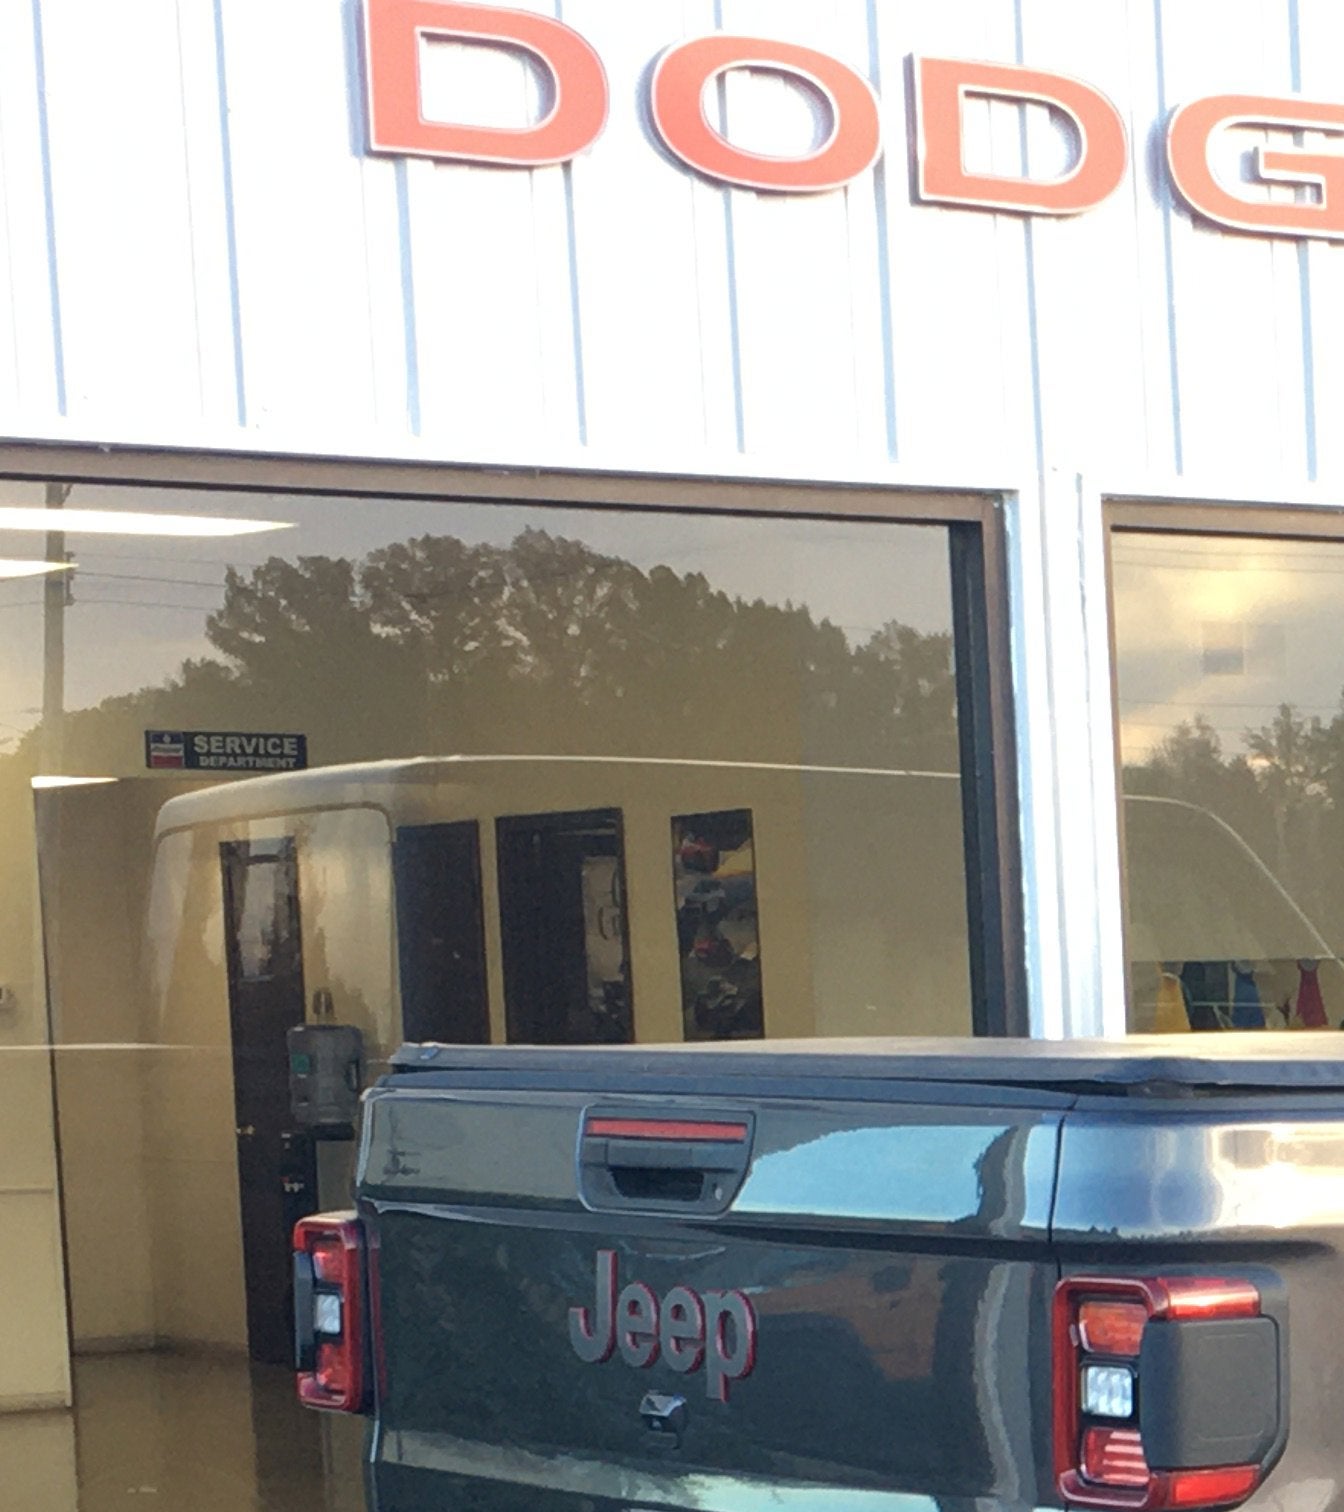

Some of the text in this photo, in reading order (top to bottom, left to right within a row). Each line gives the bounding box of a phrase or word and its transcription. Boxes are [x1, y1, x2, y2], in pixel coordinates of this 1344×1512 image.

[193, 734, 298, 756] SERVICE
[199, 755, 297, 769] DEPARTMENT
[568, 1249, 759, 1403] Jeep
